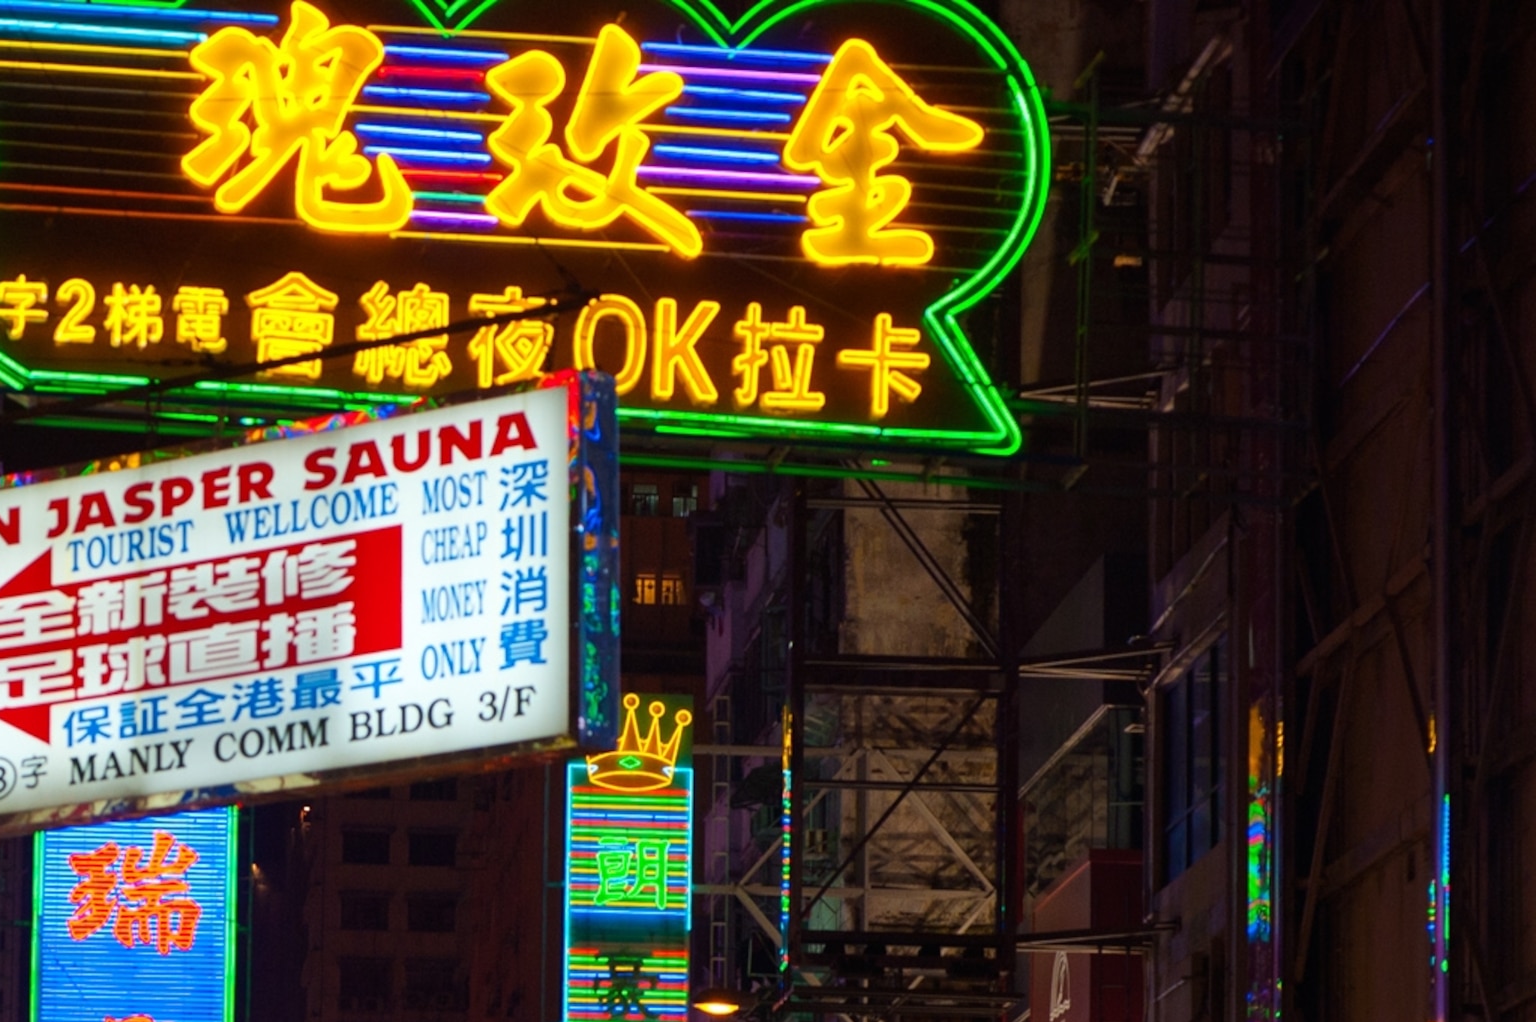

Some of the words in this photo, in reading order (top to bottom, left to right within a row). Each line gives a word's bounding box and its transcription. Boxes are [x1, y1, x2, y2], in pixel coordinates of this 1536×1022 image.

[47, 460, 276, 538] JASPER
[303, 411, 539, 491] SAUNA
[422, 470, 488, 515] MOST
[67, 520, 194, 572] TOURIST
[226, 482, 399, 544] WELLCOME
[421, 521, 488, 565] CHEAP
[499, 458, 549, 671] 深圳消費
[421, 579, 487, 624] MONEY
[63, 657, 403, 748] 保証全港最平
[421, 637, 487, 680] ONLY
[69, 739, 195, 785] MANLY
[215, 719, 328, 763] COMM
[350, 699, 453, 743] BLDG
[478, 686, 537, 722] 3/F
